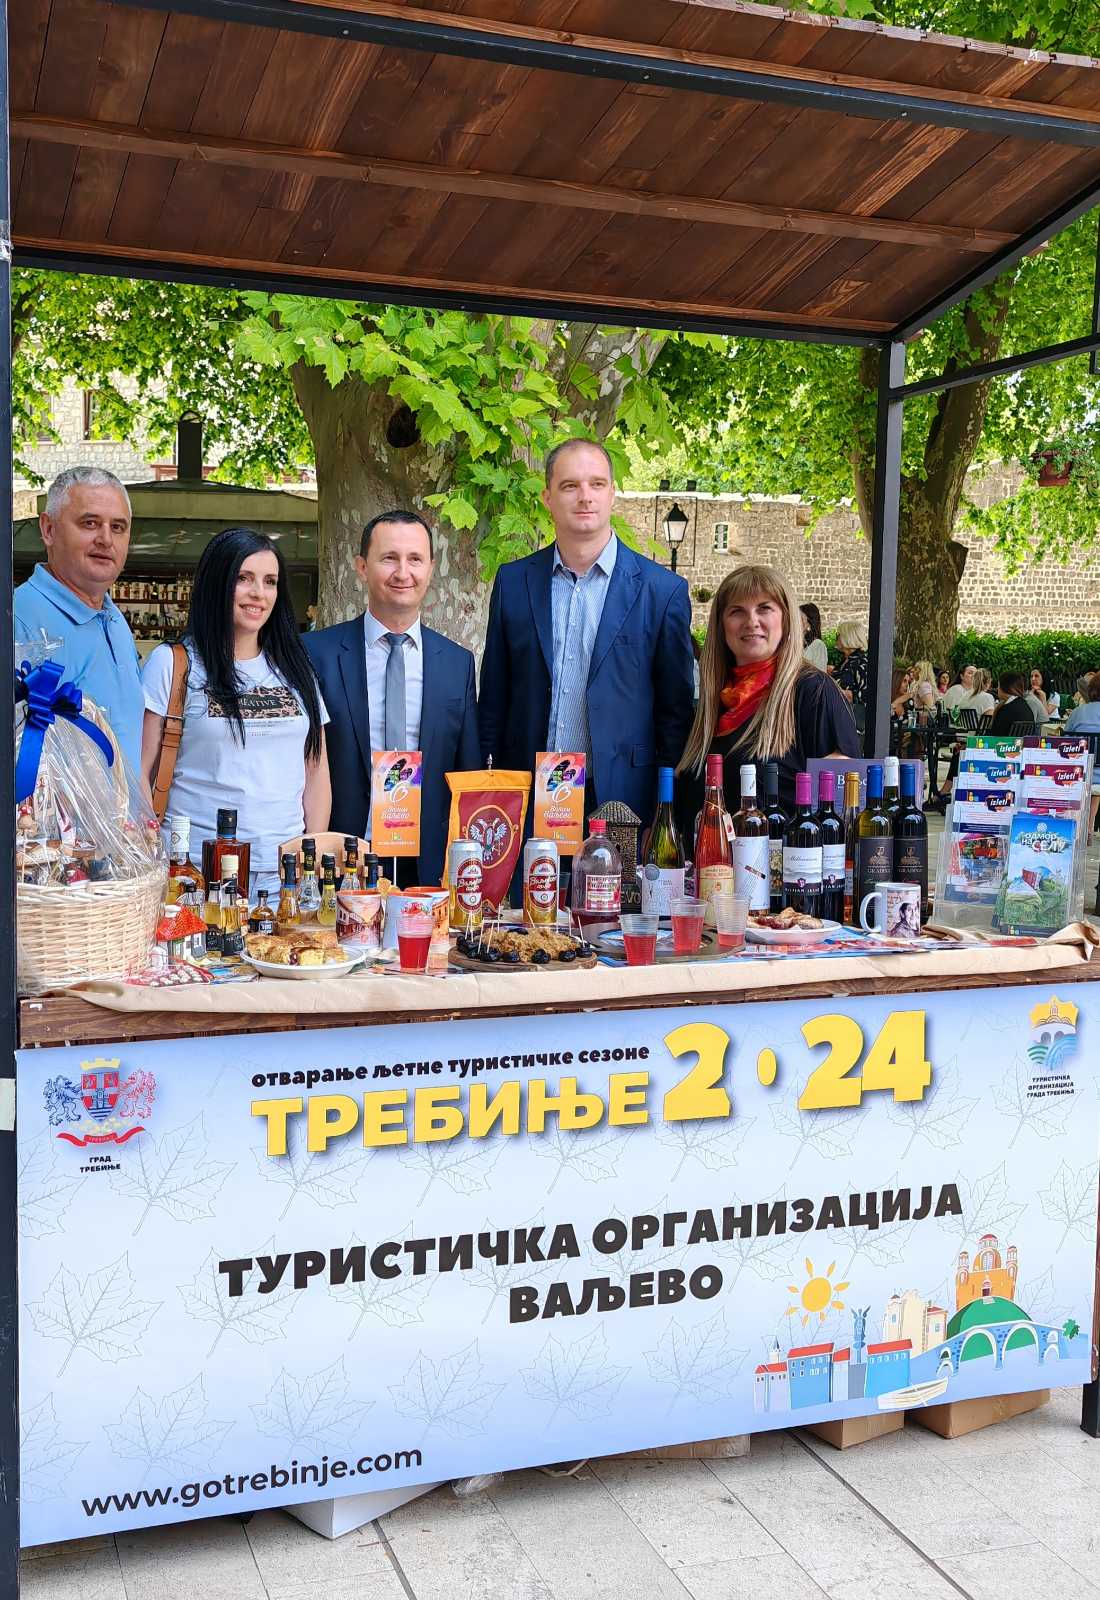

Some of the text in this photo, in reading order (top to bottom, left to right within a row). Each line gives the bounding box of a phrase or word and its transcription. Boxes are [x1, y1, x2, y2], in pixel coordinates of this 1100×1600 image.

[252, 1047, 650, 1087] отварање љетне туристичке сезоне
[1032, 1074, 1071, 1083] ТУРИСТИЧКА
[251, 1071, 650, 1156] ТРЕБИЊЕ
[80, 1163, 121, 1173] ТРЕБИЊЕ
[89, 1155, 112, 1163] ГРАД
[219, 1183, 963, 1298] ТУРИСТИЧКА ОРГАНИЗАЦИЈА
[510, 1264, 723, 1324] ВАЉЕВО
[82, 1449, 422, 1517] www.gotrebinje.com
